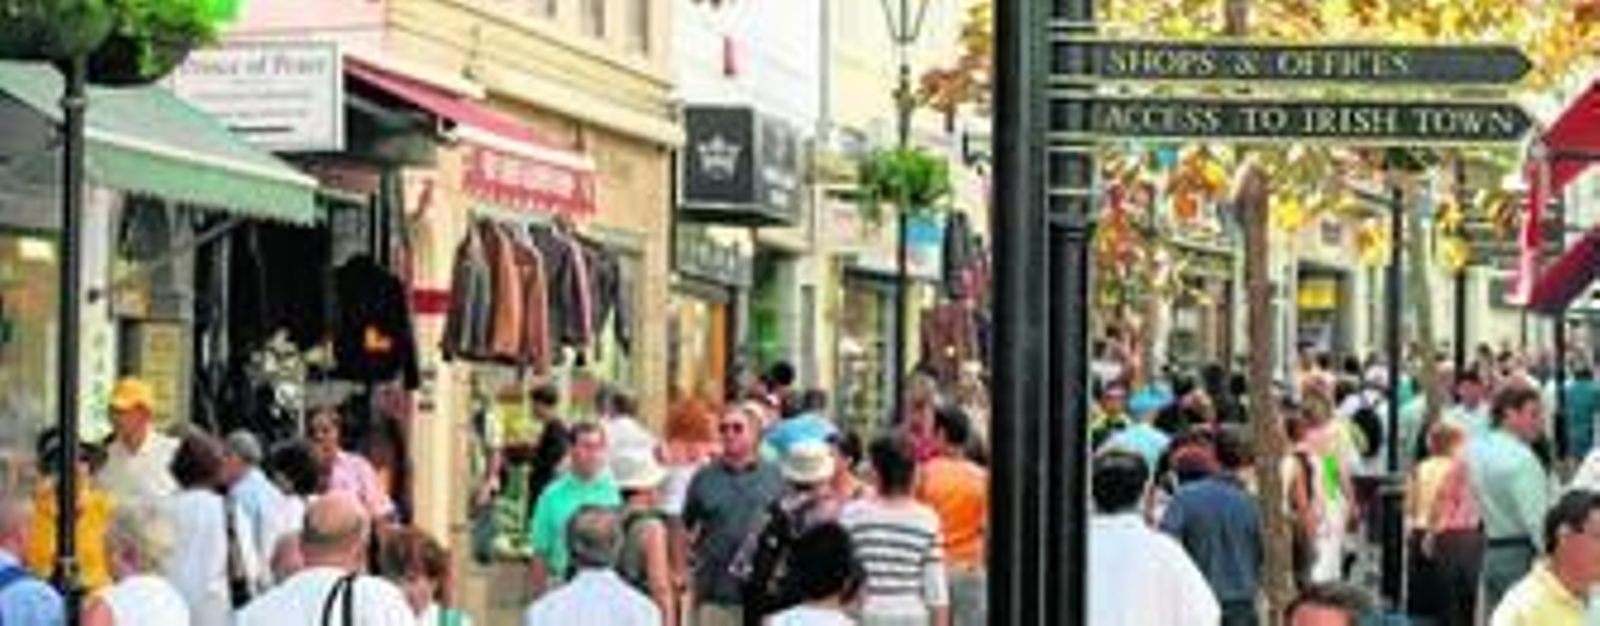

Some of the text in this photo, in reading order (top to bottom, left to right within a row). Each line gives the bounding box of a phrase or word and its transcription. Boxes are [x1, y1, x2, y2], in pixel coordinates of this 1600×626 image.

[1108, 50, 1410, 76] SHOPS & OFFICES
[1105, 104, 1517, 134] ACCESS TO IRISH TOWN
